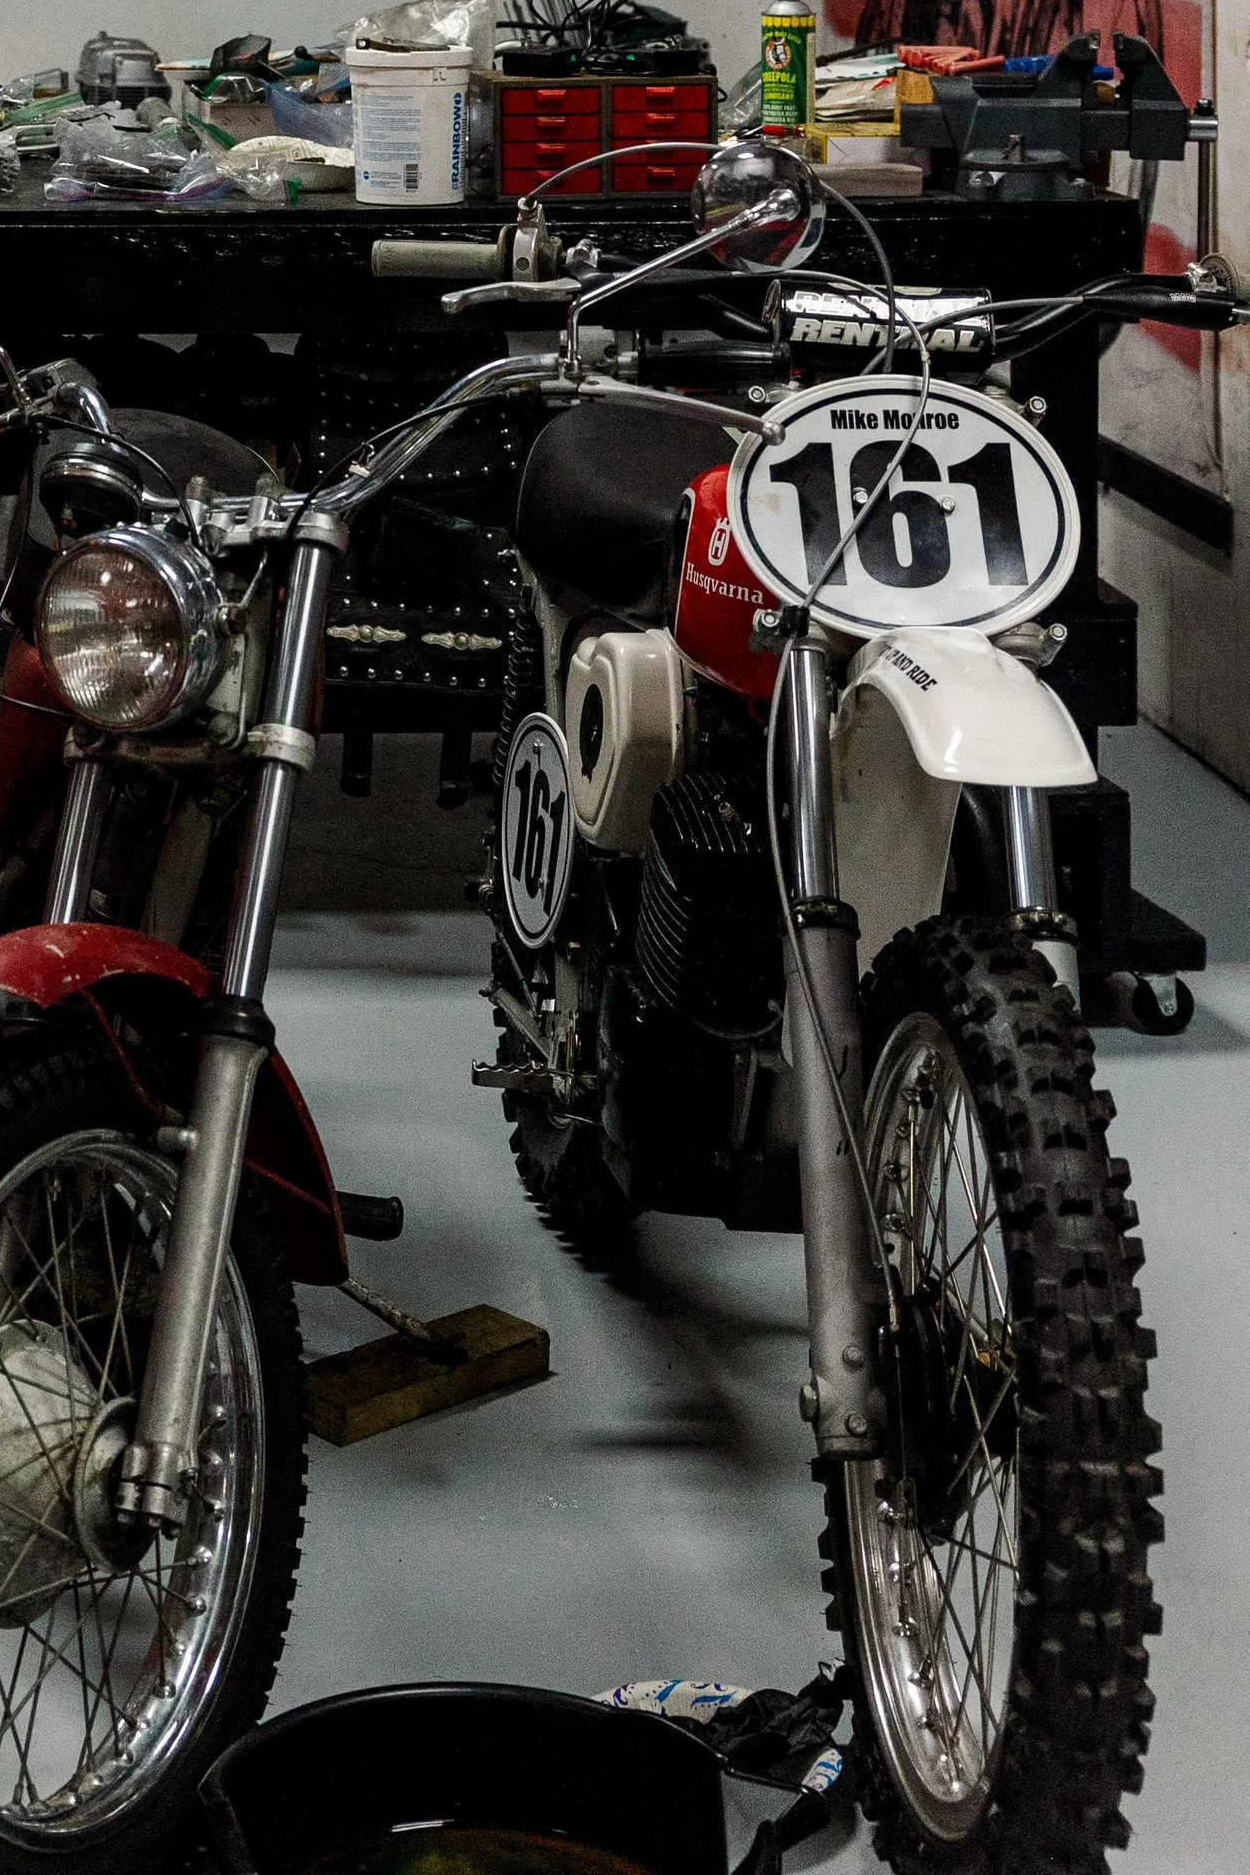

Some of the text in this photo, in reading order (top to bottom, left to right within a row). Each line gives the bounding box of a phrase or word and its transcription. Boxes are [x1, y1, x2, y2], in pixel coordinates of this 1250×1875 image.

[831, 409, 879, 429] Mike
[769, 440, 1028, 589] 161
[685, 561, 764, 605] Husqvarna
[892, 652, 914, 671] AND
[906, 665, 938, 692] RIDE
[511, 759, 566, 917] 161
